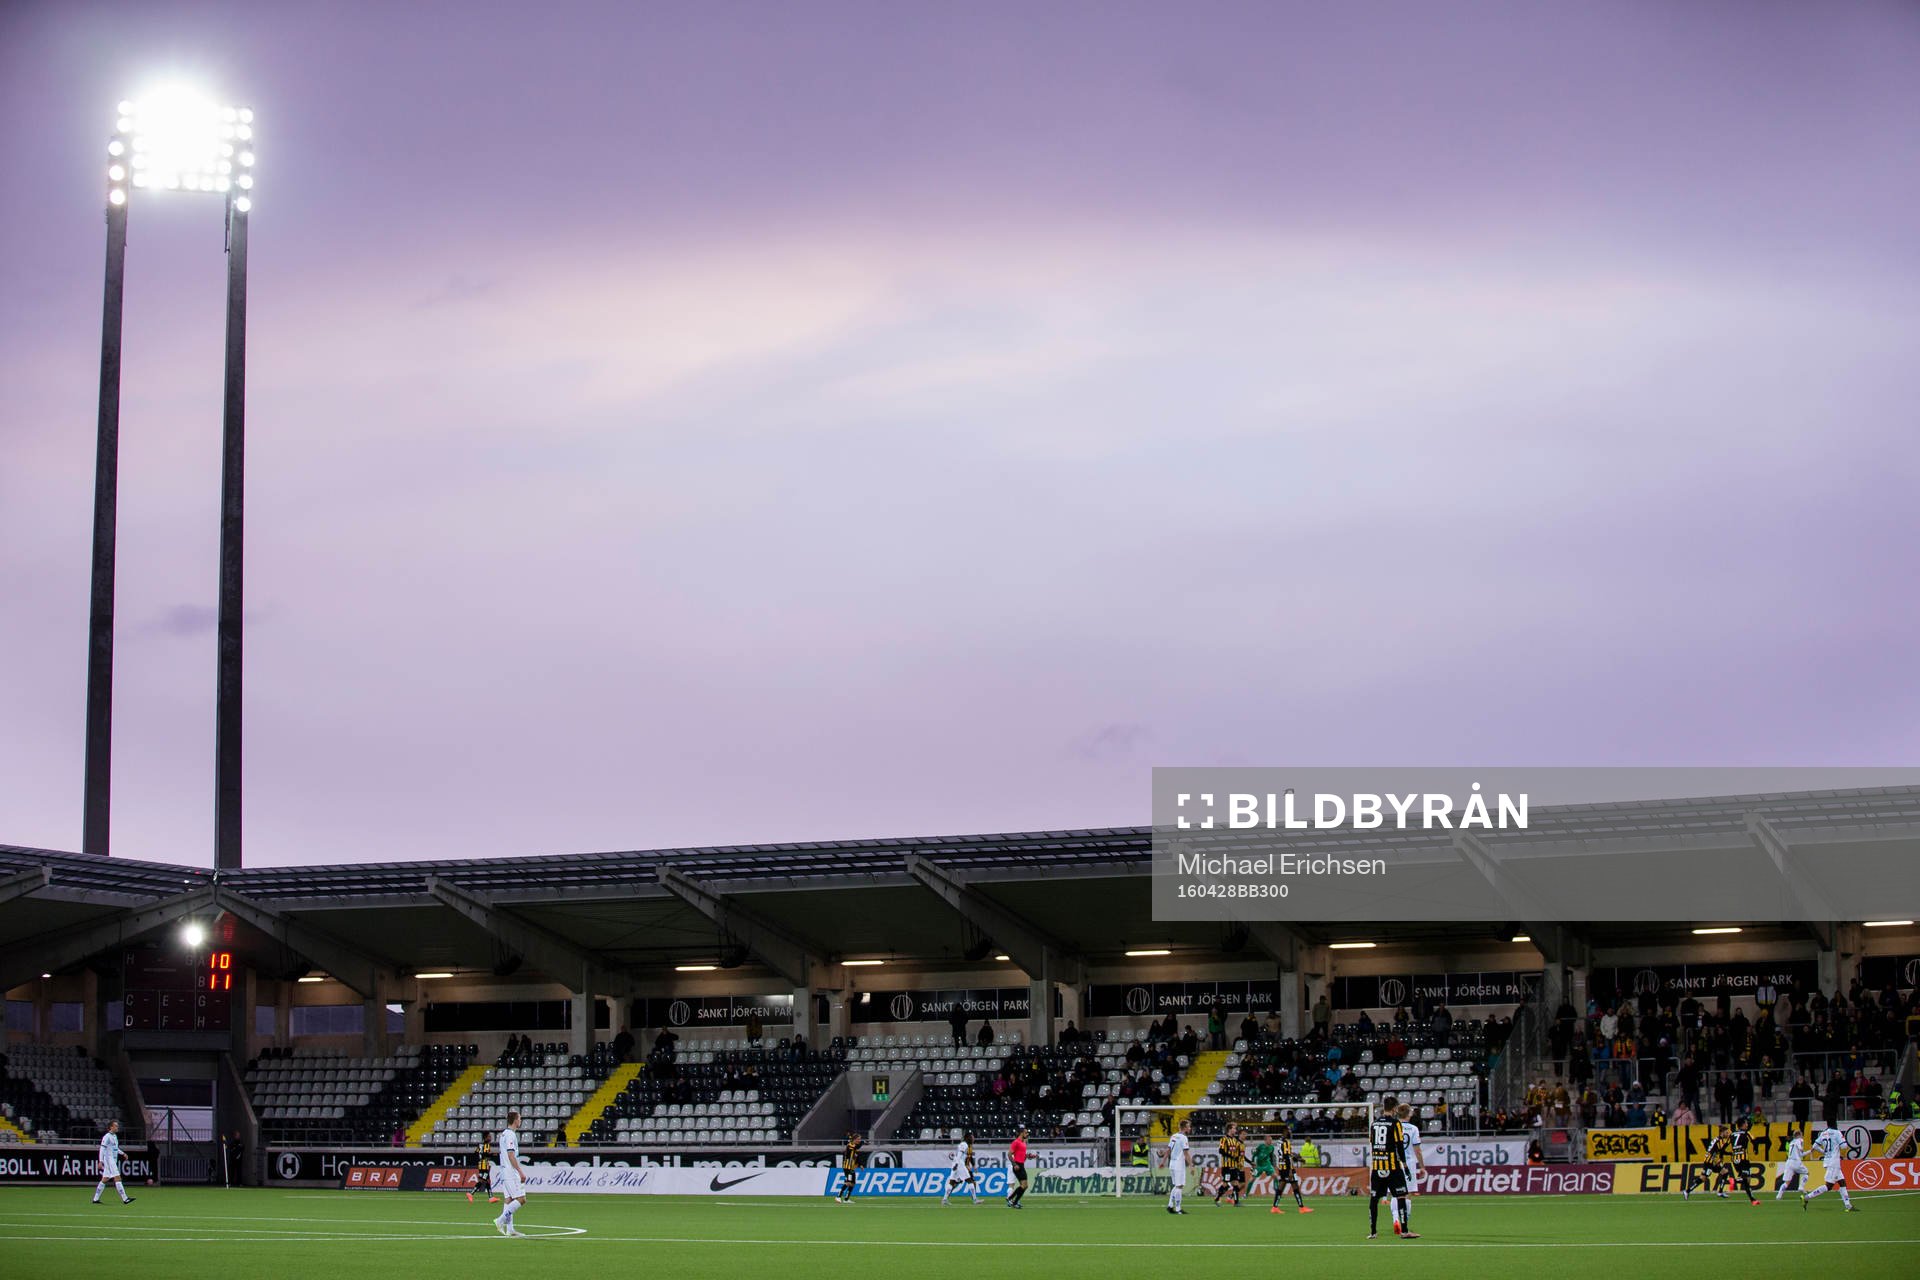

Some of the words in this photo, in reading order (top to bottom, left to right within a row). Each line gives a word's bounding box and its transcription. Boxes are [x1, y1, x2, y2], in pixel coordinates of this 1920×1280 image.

[1670, 977, 1705, 989] SANKT
[1711, 975, 1758, 988] JRGEN
[1767, 974, 1792, 985] ARK
[1456, 983, 1500, 997] JÖRGEN
[921, 1002, 953, 1013] SANKT
[959, 999, 998, 1012] ÖRGEN
[1003, 1000, 1029, 1011] PARK
[1159, 995, 1192, 1007] SANKT
[1246, 993, 1272, 1004] PARK
[698, 1008, 728, 1019] SANKT
[732, 1005, 770, 1018] JÖRGEN
[774, 1007, 792, 1017] PAR
[1373, 1125, 1388, 1145] 18
[1822, 1138, 1832, 1153] 21
[1447, 1144, 1509, 1166] higab
[43, 1158, 57, 1175] VI
[62, 1155, 81, 1175] ÄR
[85, 1159, 153, 1177] HIGEN.
[351, 1171, 398, 1182] BRA
[431, 1172, 479, 1183] BRA
[831, 1171, 1009, 1194] EHRENBRG
[1526, 1167, 1612, 1193] Finans
[1249, 1174, 1350, 1196] Rova
